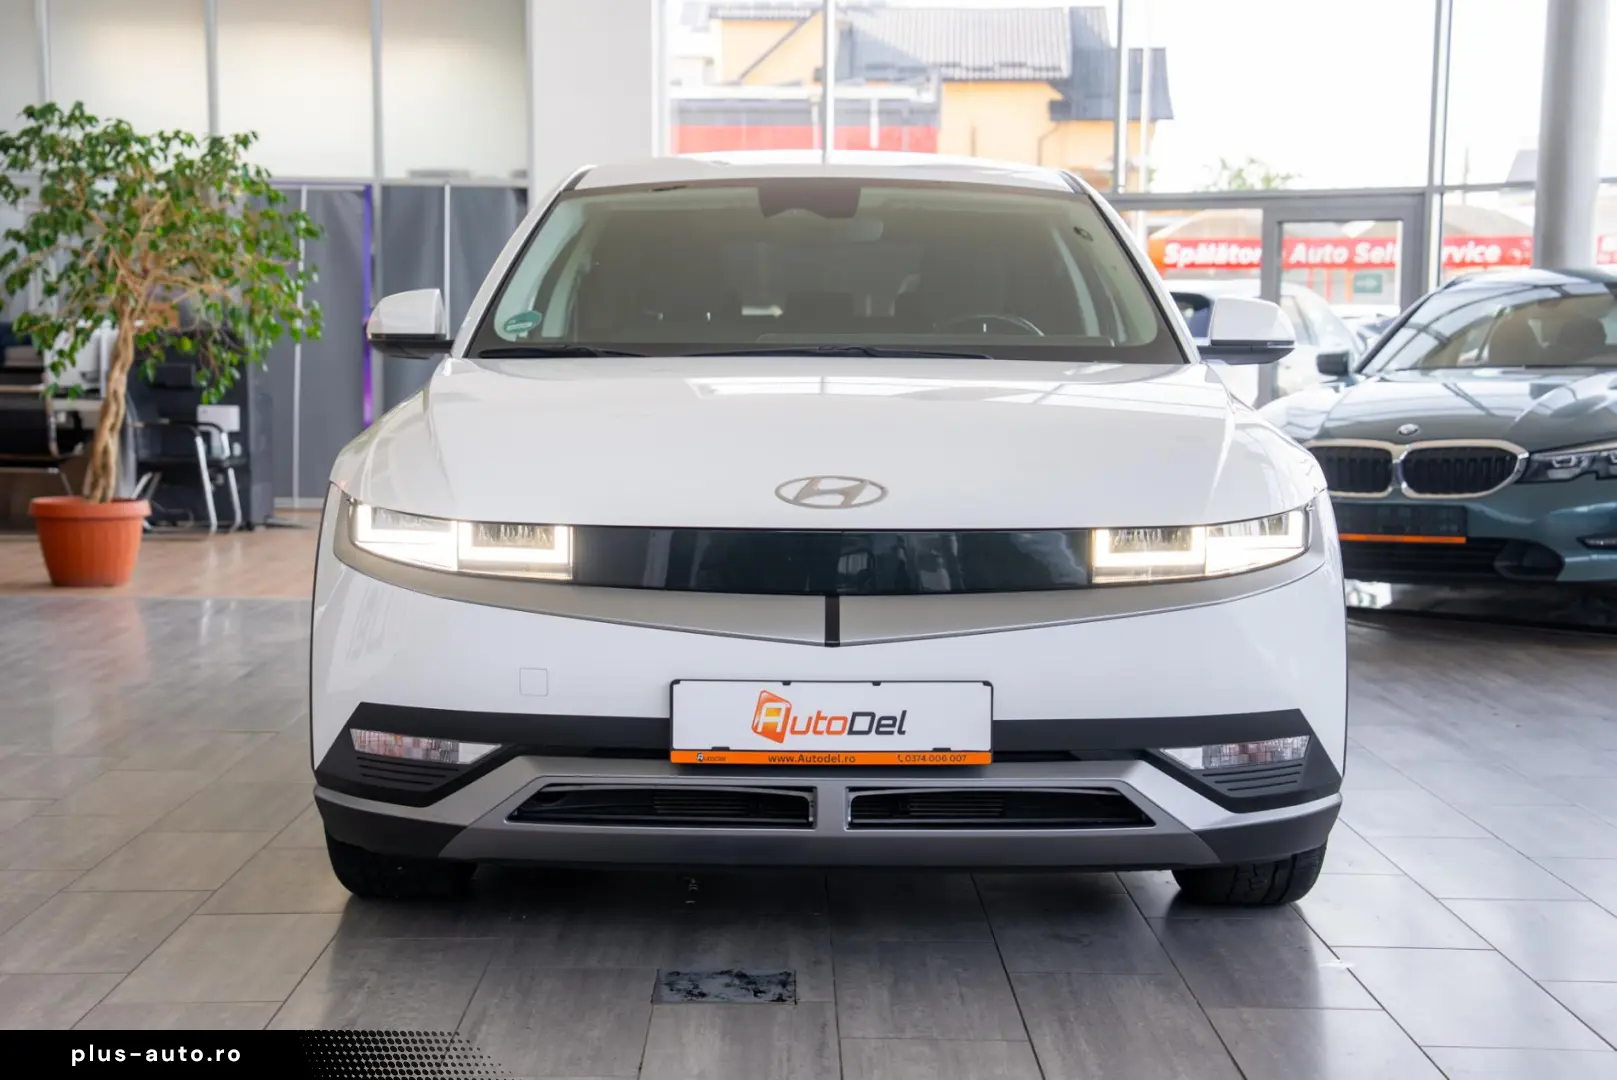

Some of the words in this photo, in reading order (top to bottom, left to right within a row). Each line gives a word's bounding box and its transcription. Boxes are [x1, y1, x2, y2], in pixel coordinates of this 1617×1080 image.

[1289, 242, 1349, 264] Auto
[1443, 240, 1501, 263] rvice
[752, 693, 907, 741] AutoDel
[768, 753, 856, 763] www.Autodel.ro
[905, 754, 926, 762] 0374
[949, 754, 967, 762] 007
